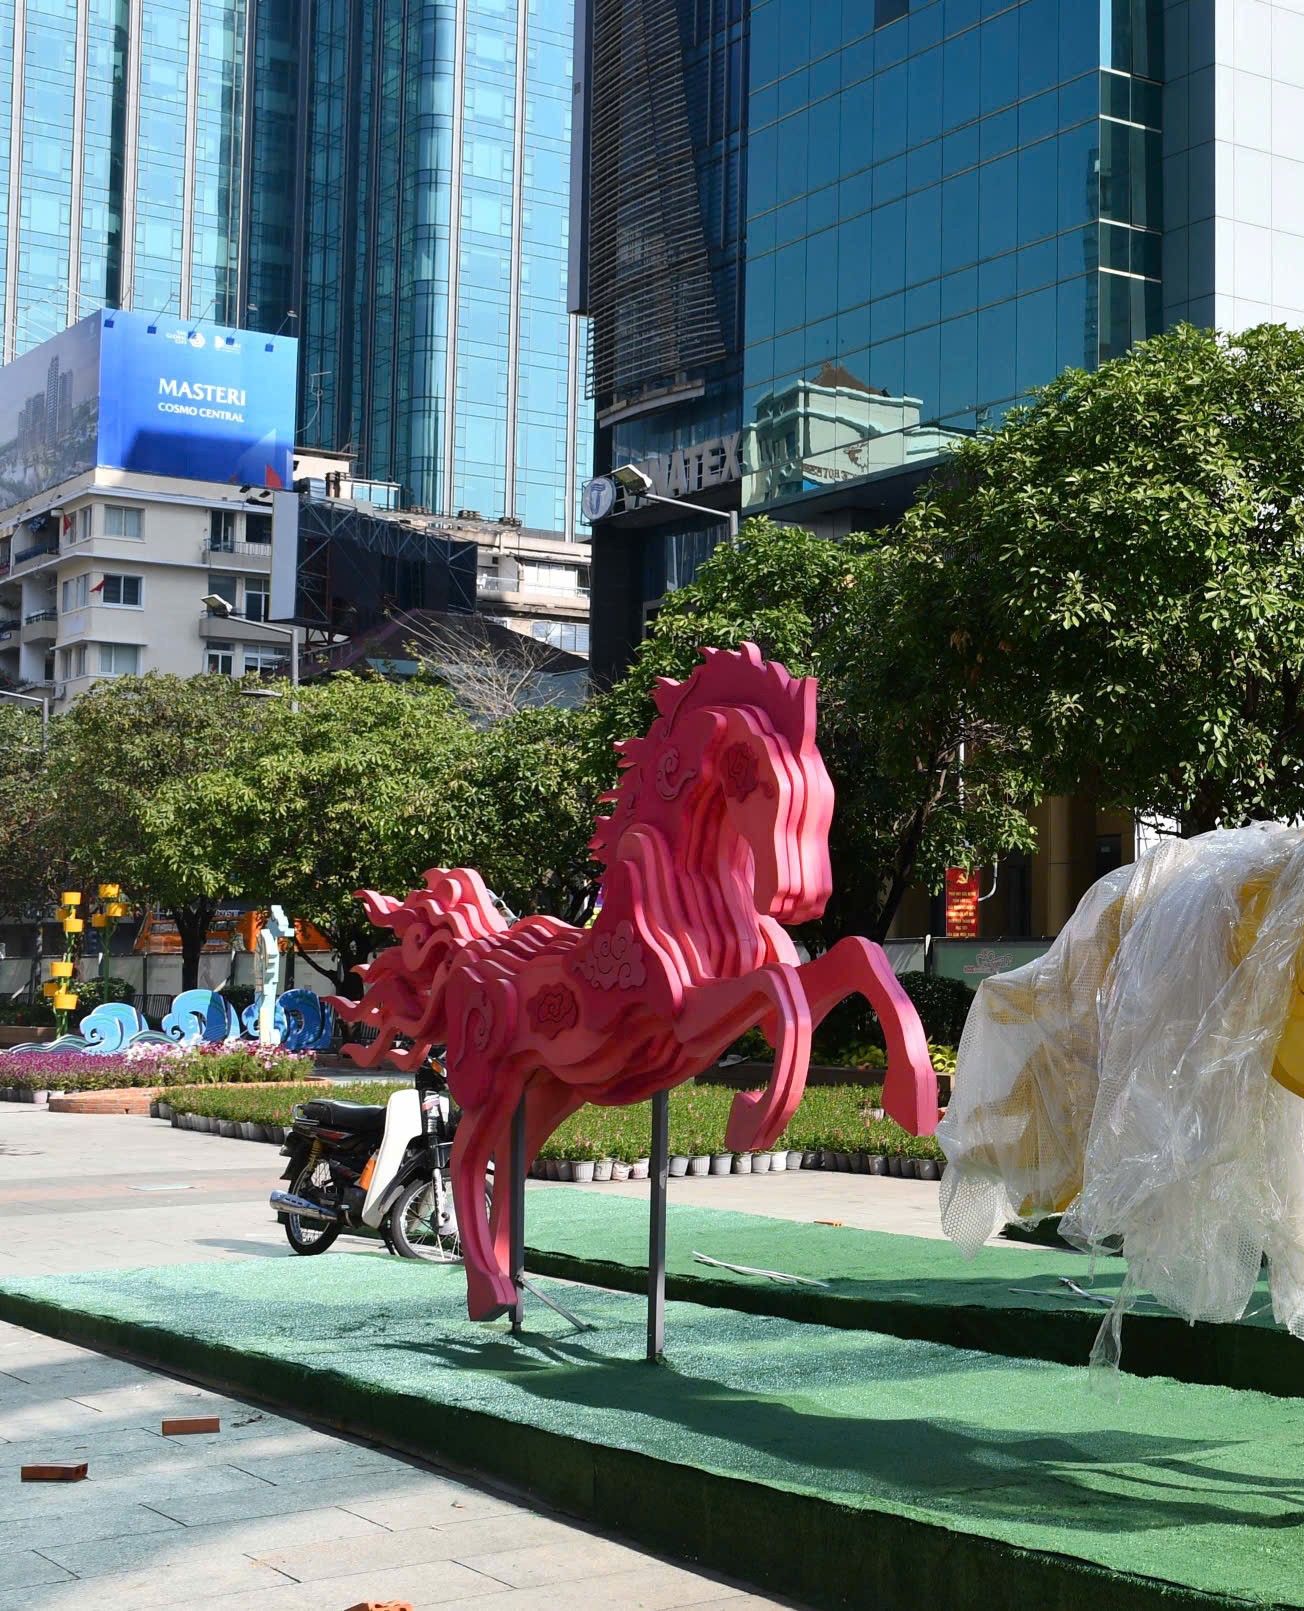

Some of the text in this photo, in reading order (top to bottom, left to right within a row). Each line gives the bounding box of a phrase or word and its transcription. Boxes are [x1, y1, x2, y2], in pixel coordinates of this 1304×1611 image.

[158, 377, 246, 406] MASTERI
[158, 402, 245, 423] COSMO CENTRAL
